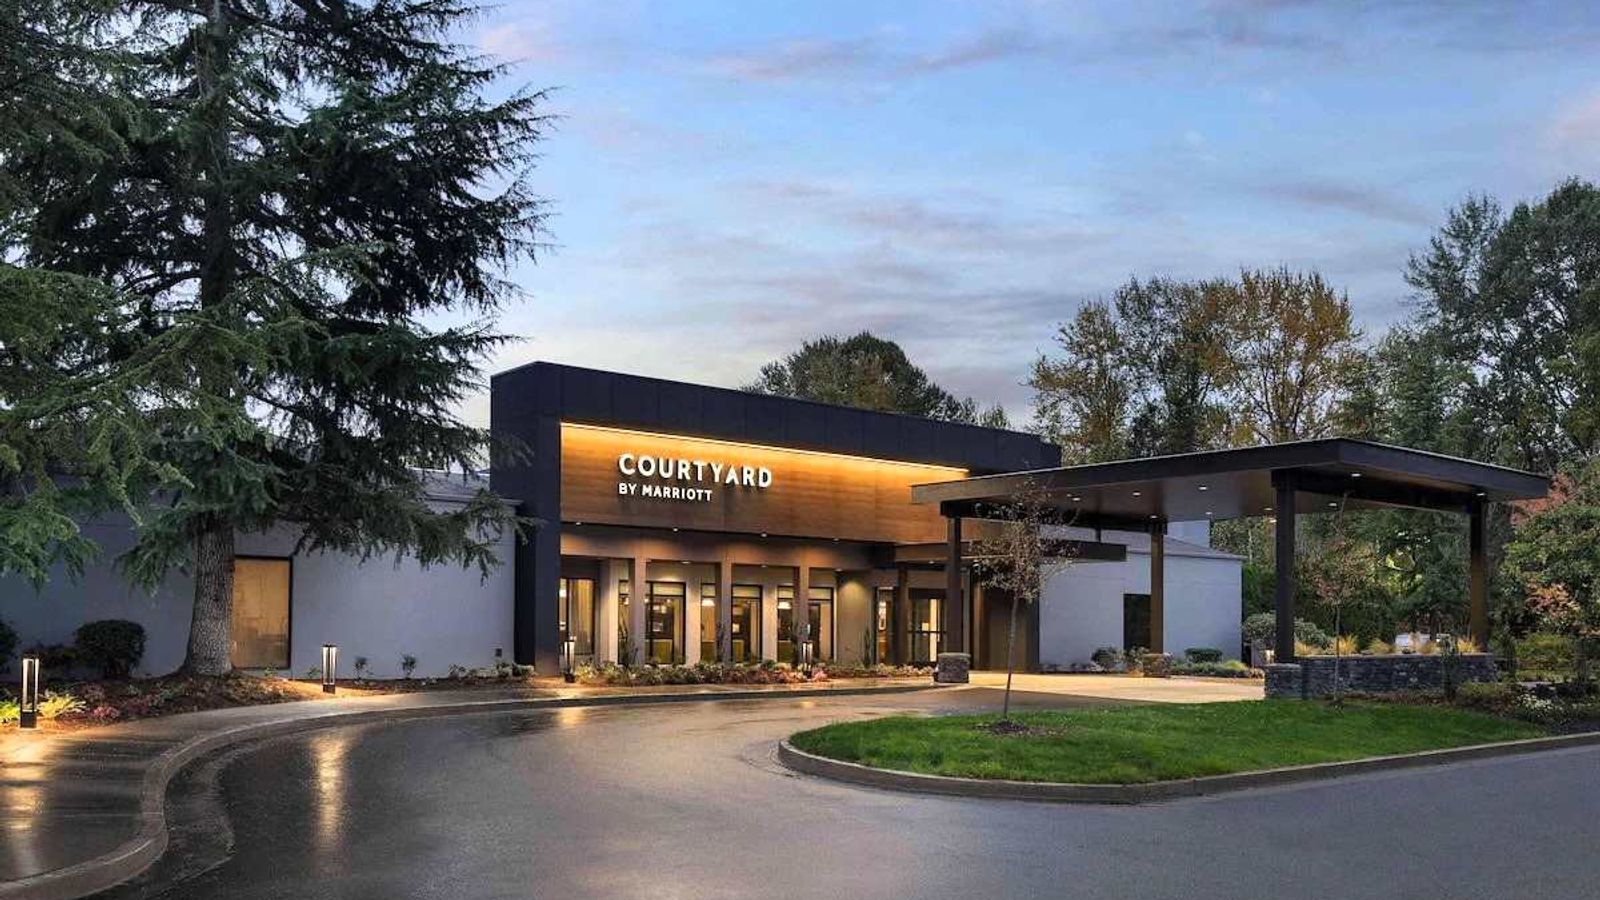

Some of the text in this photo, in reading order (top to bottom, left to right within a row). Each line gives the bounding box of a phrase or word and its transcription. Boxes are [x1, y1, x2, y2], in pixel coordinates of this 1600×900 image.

[618, 453, 773, 488] COURTYARD
[618, 482, 713, 501] BY MARRIOTT
